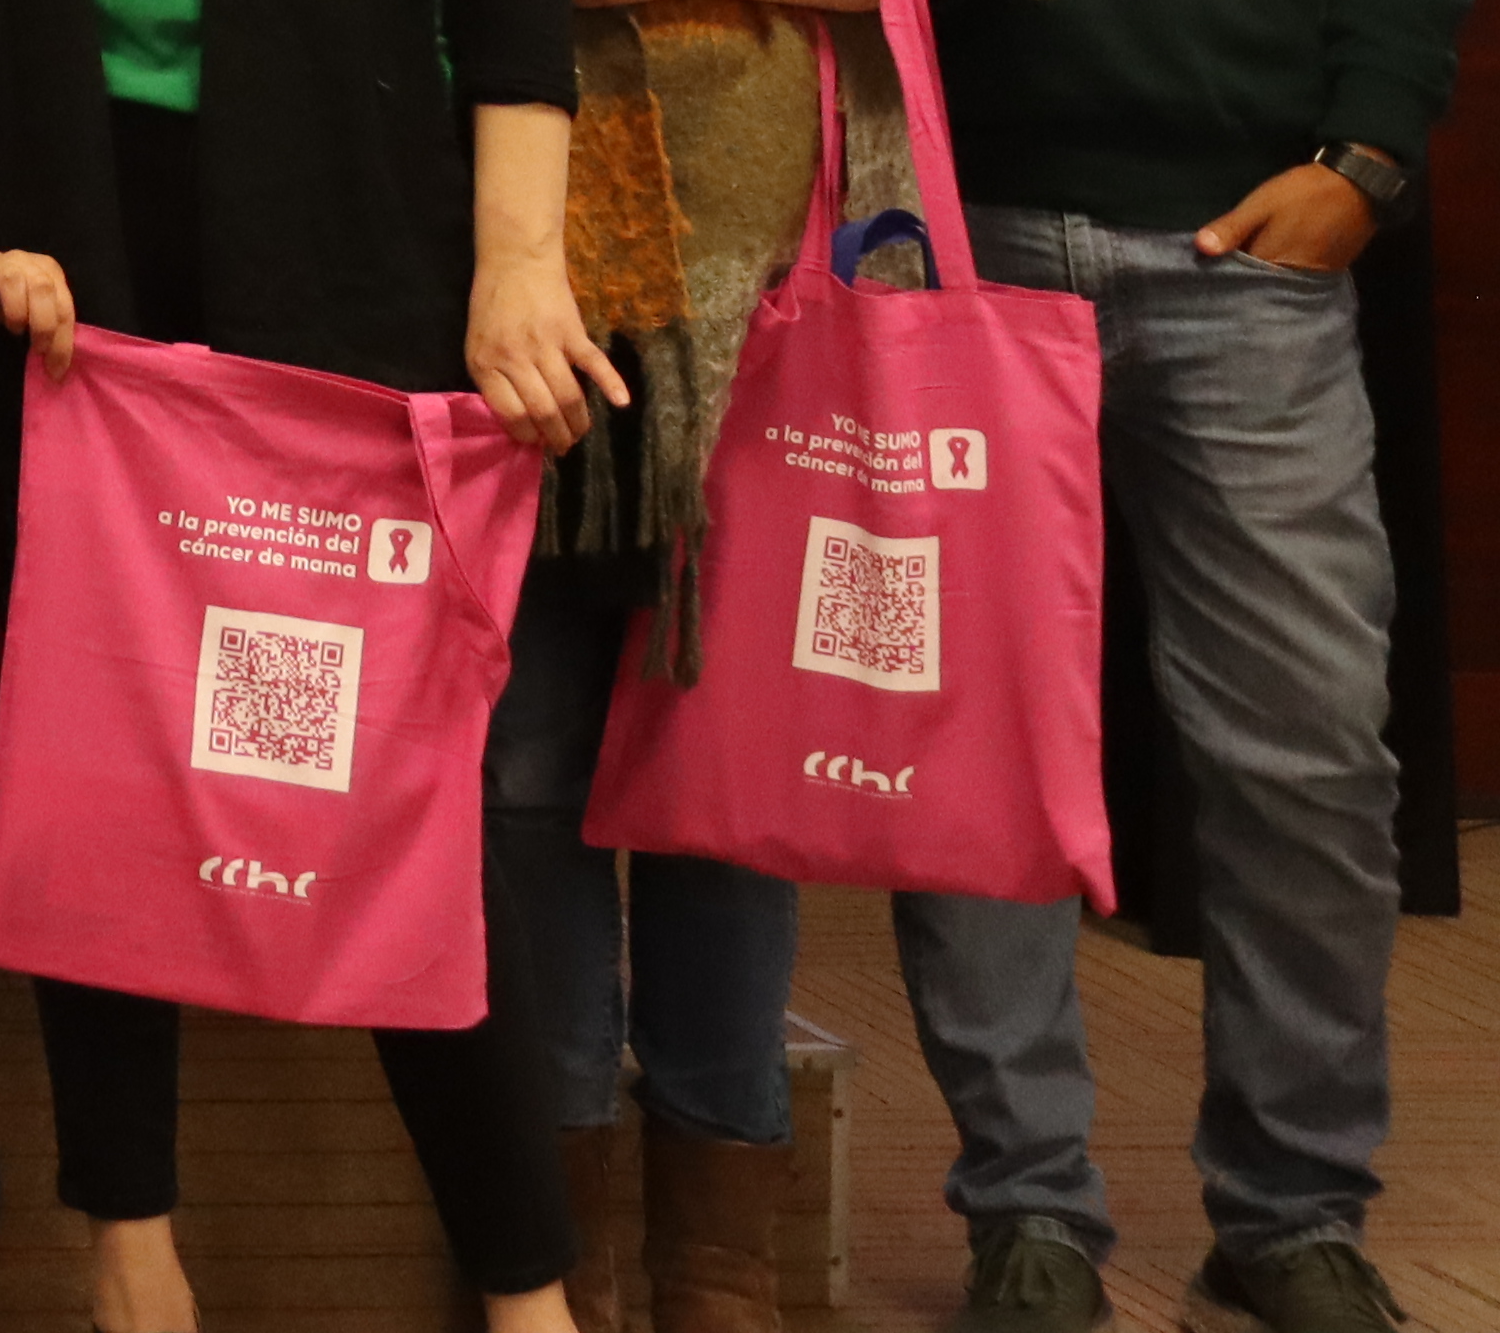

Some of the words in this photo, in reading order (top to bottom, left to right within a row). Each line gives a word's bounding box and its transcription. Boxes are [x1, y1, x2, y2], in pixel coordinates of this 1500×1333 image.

[765, 427, 778, 440] a
[784, 425, 804, 444] la
[903, 451, 922, 470] del
[831, 413, 856, 434] YO
[874, 430, 921, 450] SUMO
[785, 452, 854, 477] cáncer
[871, 478, 926, 493] mama
[158, 511, 173, 525] a
[178, 510, 199, 530] la
[204, 518, 319, 548] prevención
[325, 534, 360, 554] del
[227, 495, 256, 517] YO
[261, 501, 292, 522] ME
[297, 507, 362, 532] SUMO
[179, 538, 253, 562] cáncer
[258, 547, 285, 566] de
[291, 555, 356, 578] mama
